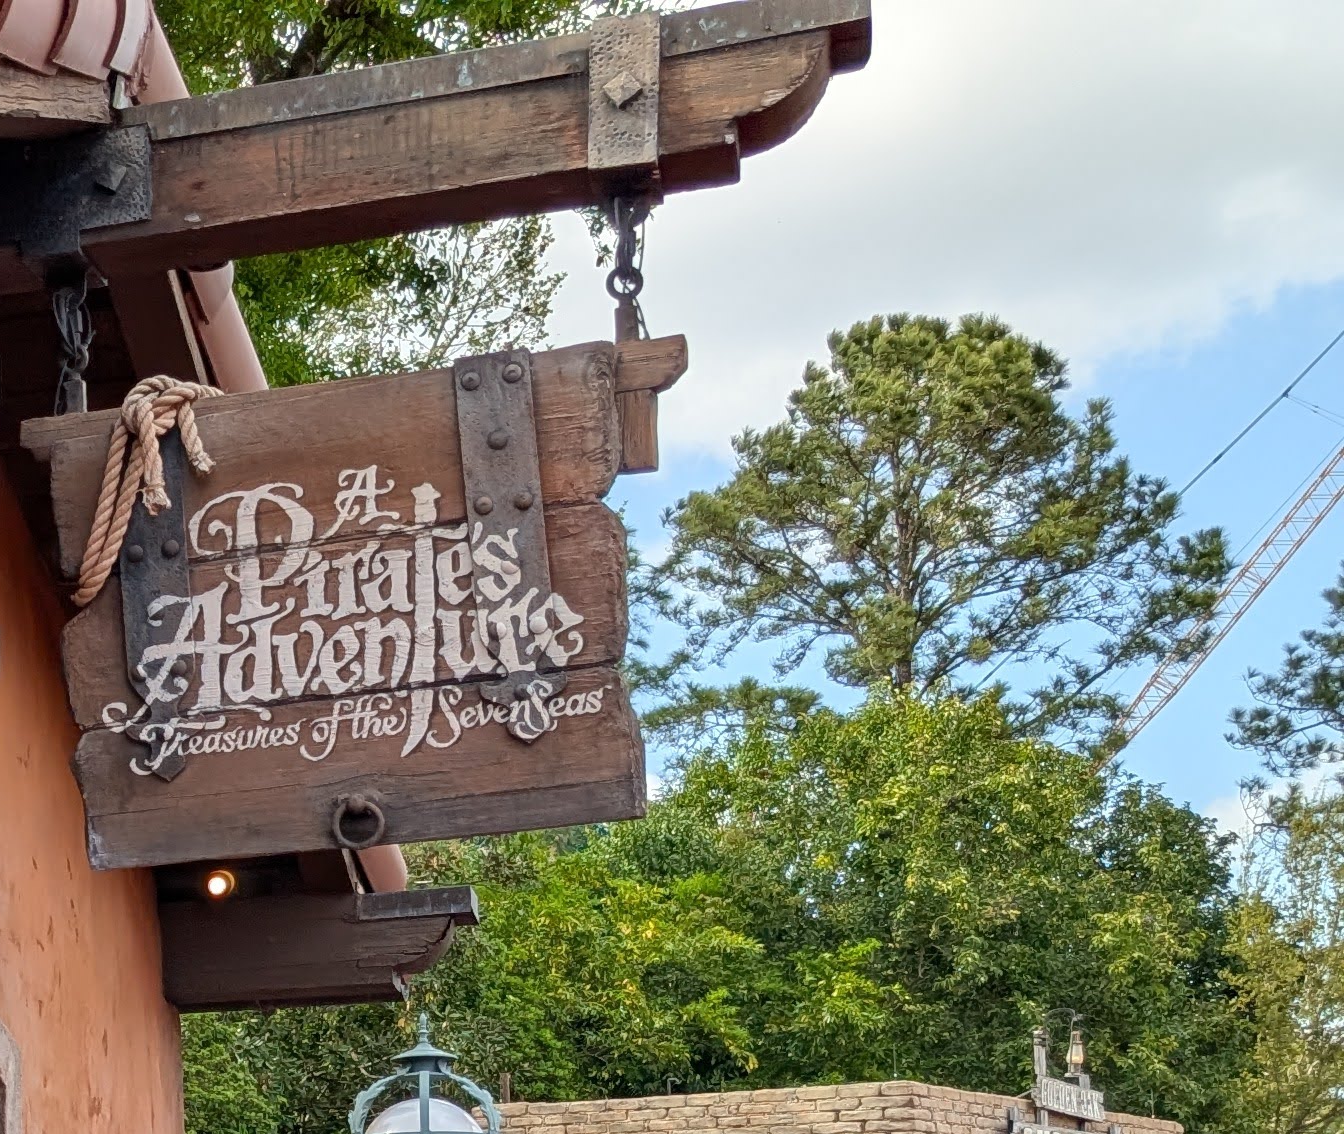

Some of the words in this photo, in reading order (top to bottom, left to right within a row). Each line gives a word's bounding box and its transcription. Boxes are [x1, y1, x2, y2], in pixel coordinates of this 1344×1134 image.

[189, 482, 522, 624] Pirate's
[319, 464, 400, 538] A
[102, 581, 584, 757] Adventure
[129, 714, 307, 776] Treasures
[426, 685, 534, 748] Seven
[515, 680, 612, 741] Seas
